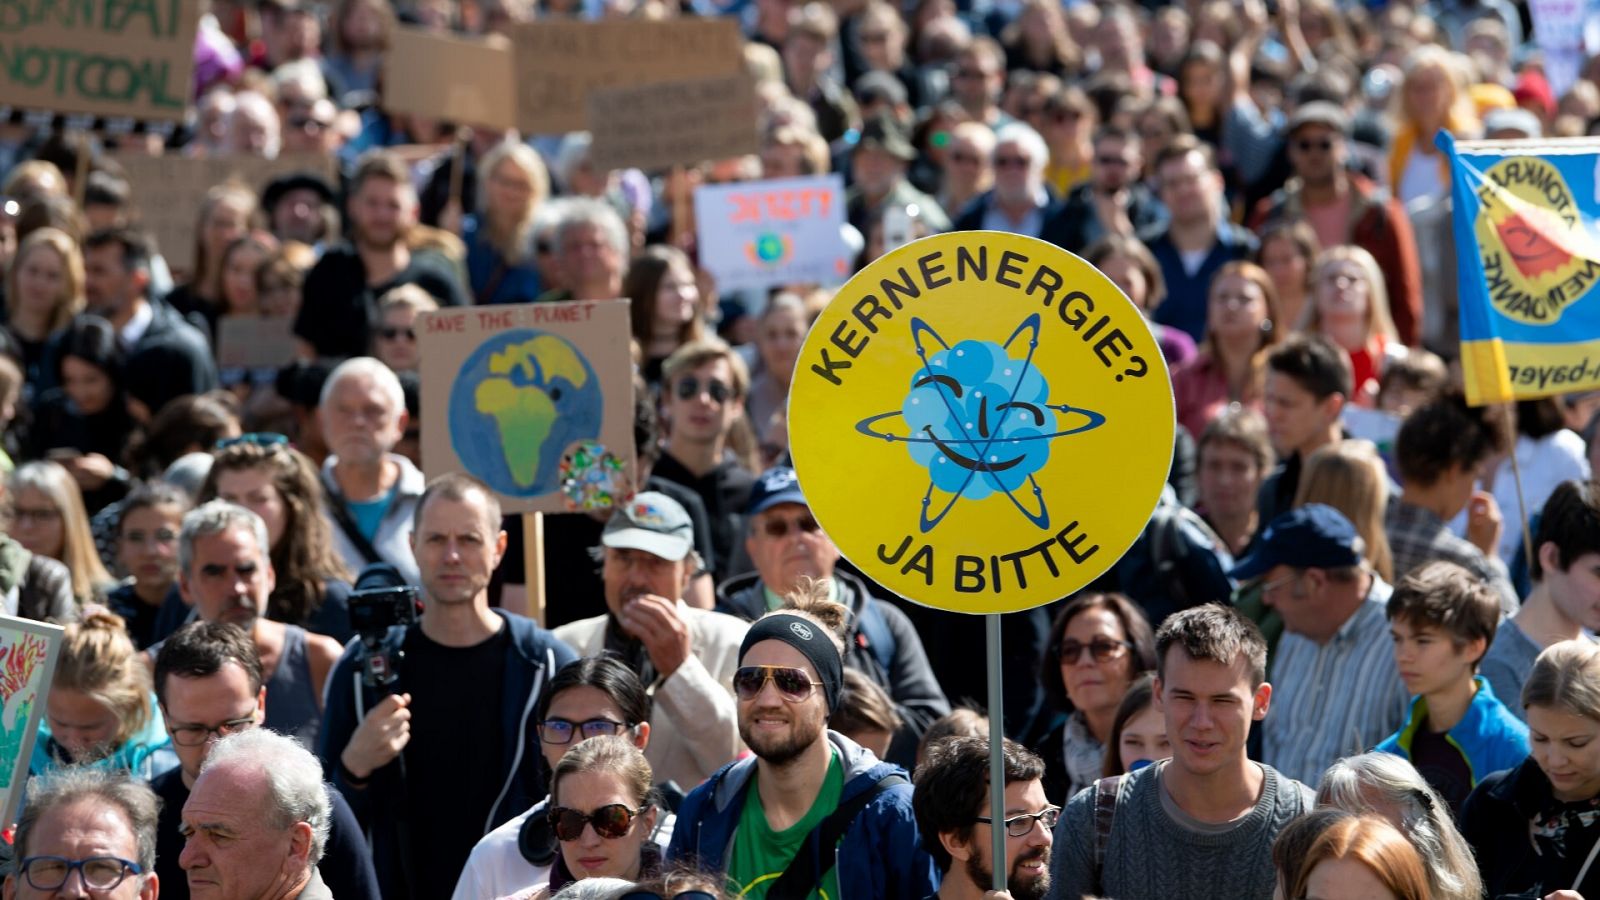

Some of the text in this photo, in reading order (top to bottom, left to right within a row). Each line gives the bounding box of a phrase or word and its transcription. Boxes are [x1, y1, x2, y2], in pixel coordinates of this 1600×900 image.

[425, 303, 595, 334] SAVE THE PLANET
[811, 245, 1148, 386] KERNENERGIE?
[877, 520, 1099, 593] JA BITTE
